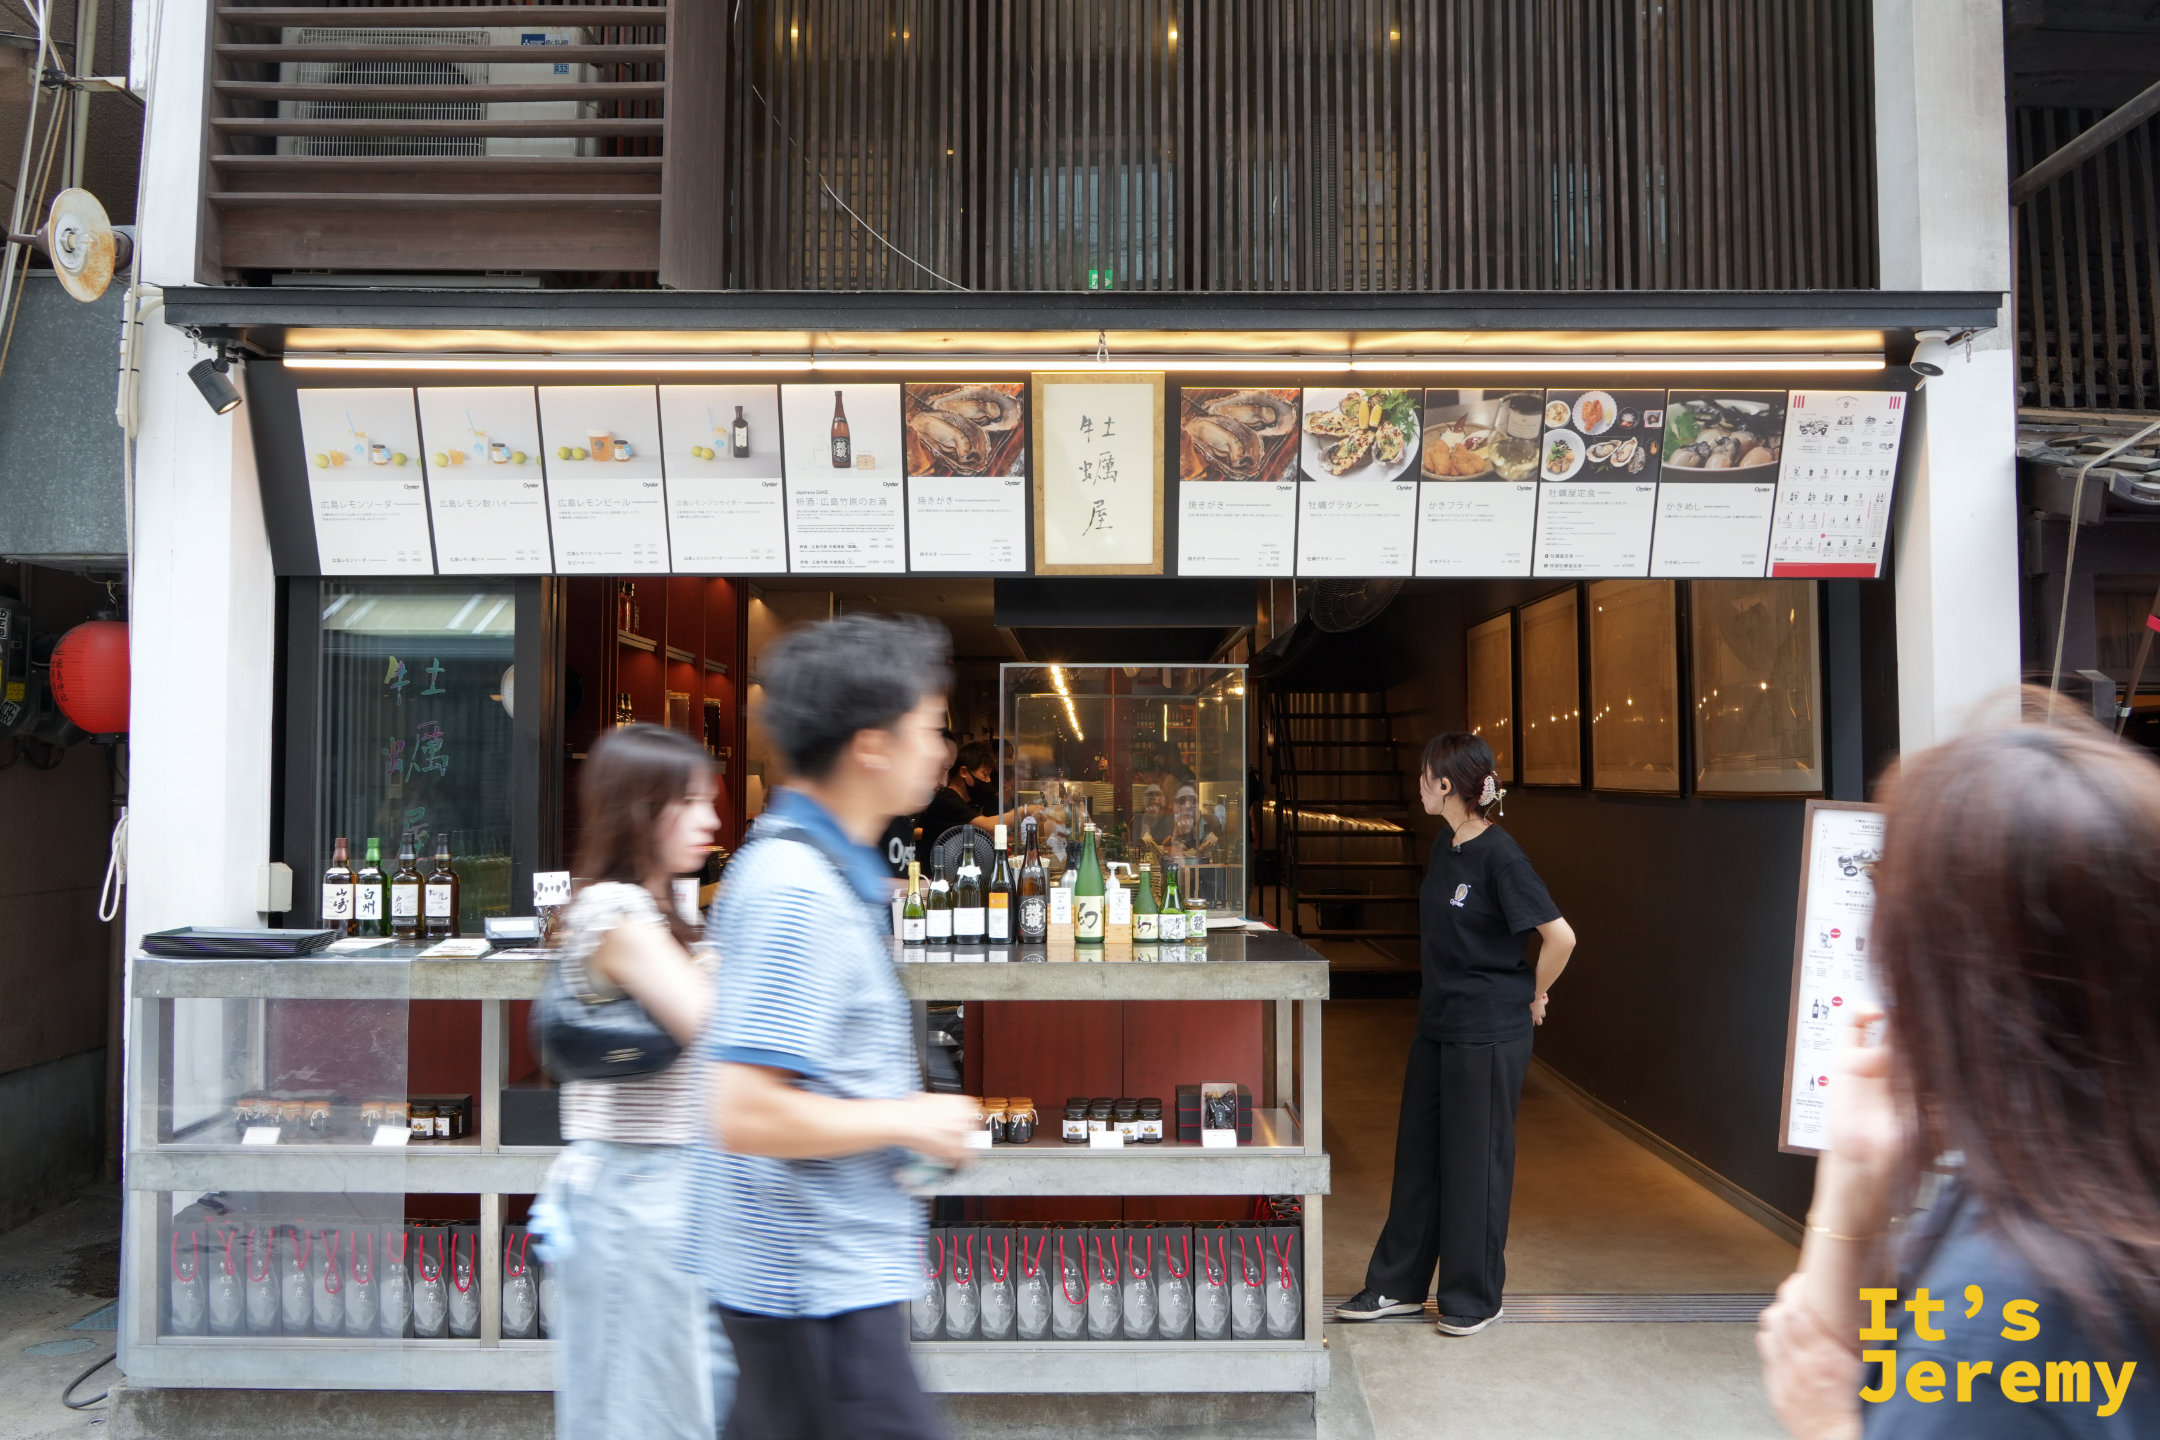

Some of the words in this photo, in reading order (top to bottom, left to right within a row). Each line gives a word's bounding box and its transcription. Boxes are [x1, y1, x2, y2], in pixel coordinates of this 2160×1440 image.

[1079, 414, 1118, 536] 牡蠣屋
[1549, 489, 1595, 498] 牡蠣屋定食
[321, 500, 392, 509] 広島レモンソーダ
[440, 500, 508, 508] 広島レモン酎ハイ
[558, 498, 631, 507] 広島レモンビール
[917, 496, 953, 505] 焼きがき
[1188, 501, 1224, 509] 焼きがき
[1308, 501, 1362, 509] 牡蠣グラタン
[1429, 502, 1472, 510] かきフライ
[1666, 502, 1701, 511] かきめし
[333, 888, 349, 914] 山崎
[362, 888, 375, 915] 白州
